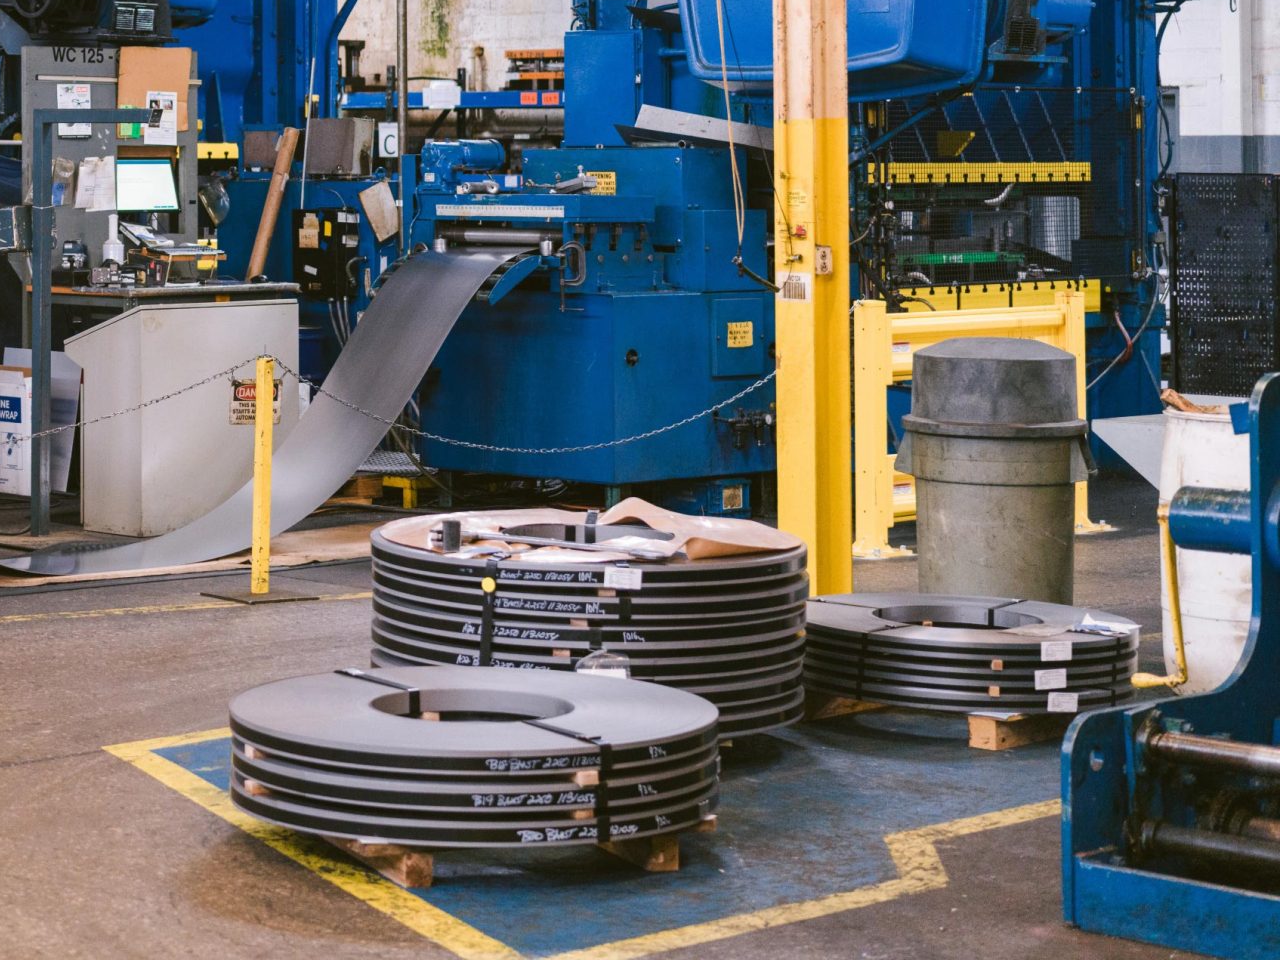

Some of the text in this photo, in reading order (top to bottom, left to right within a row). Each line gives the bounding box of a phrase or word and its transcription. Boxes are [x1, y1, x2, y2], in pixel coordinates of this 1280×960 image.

[52, 47, 76, 63] WC
[81, 47, 104, 64] 125
[383, 134, 396, 155] C
